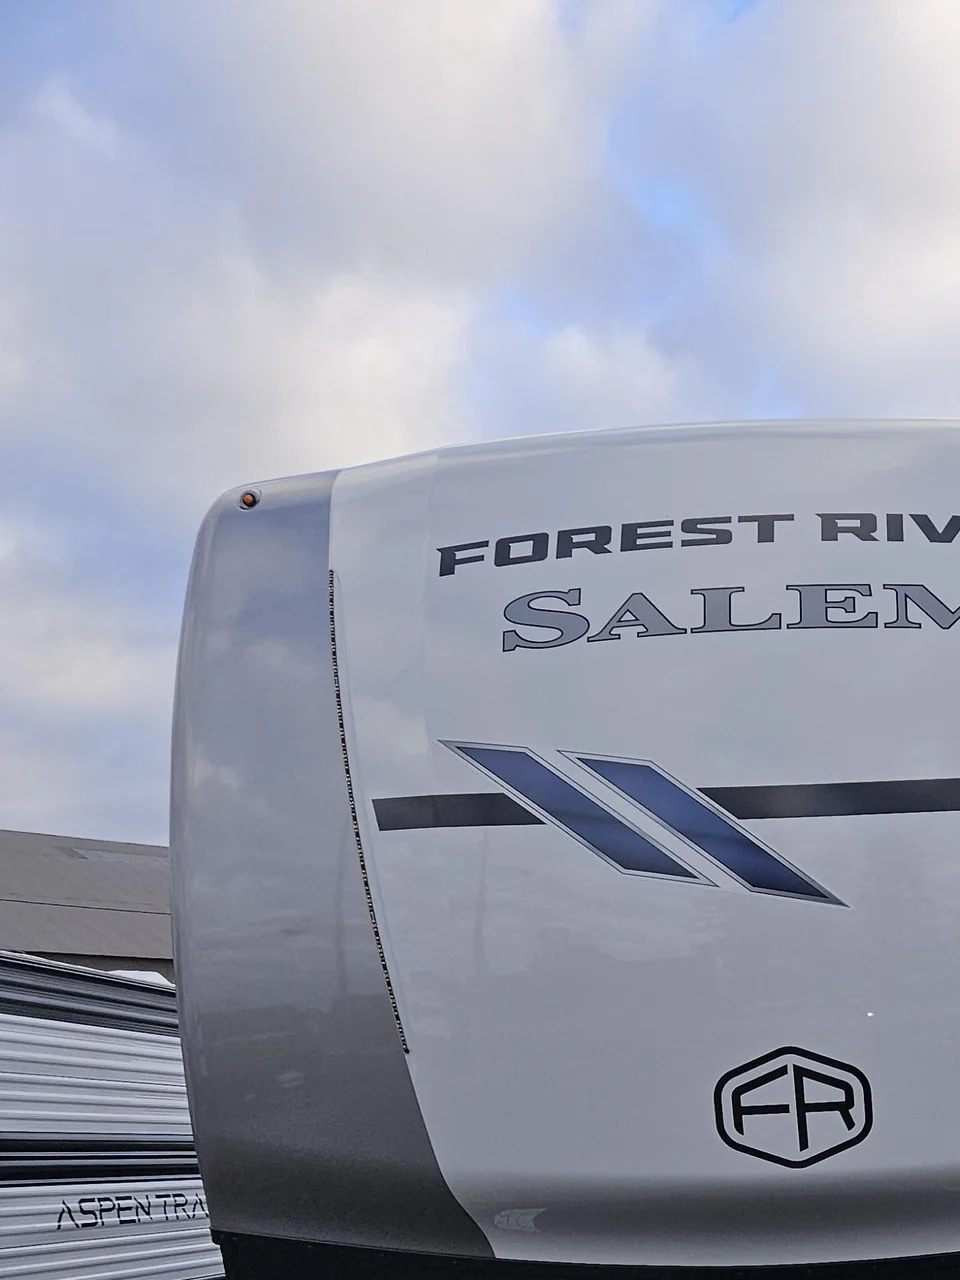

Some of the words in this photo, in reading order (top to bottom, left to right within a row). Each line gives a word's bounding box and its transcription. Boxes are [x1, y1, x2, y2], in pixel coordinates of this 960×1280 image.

[437, 513, 795, 577] FOREST
[56, 1194, 153, 1230] ASPEN
[155, 1192, 209, 1221] TRA
